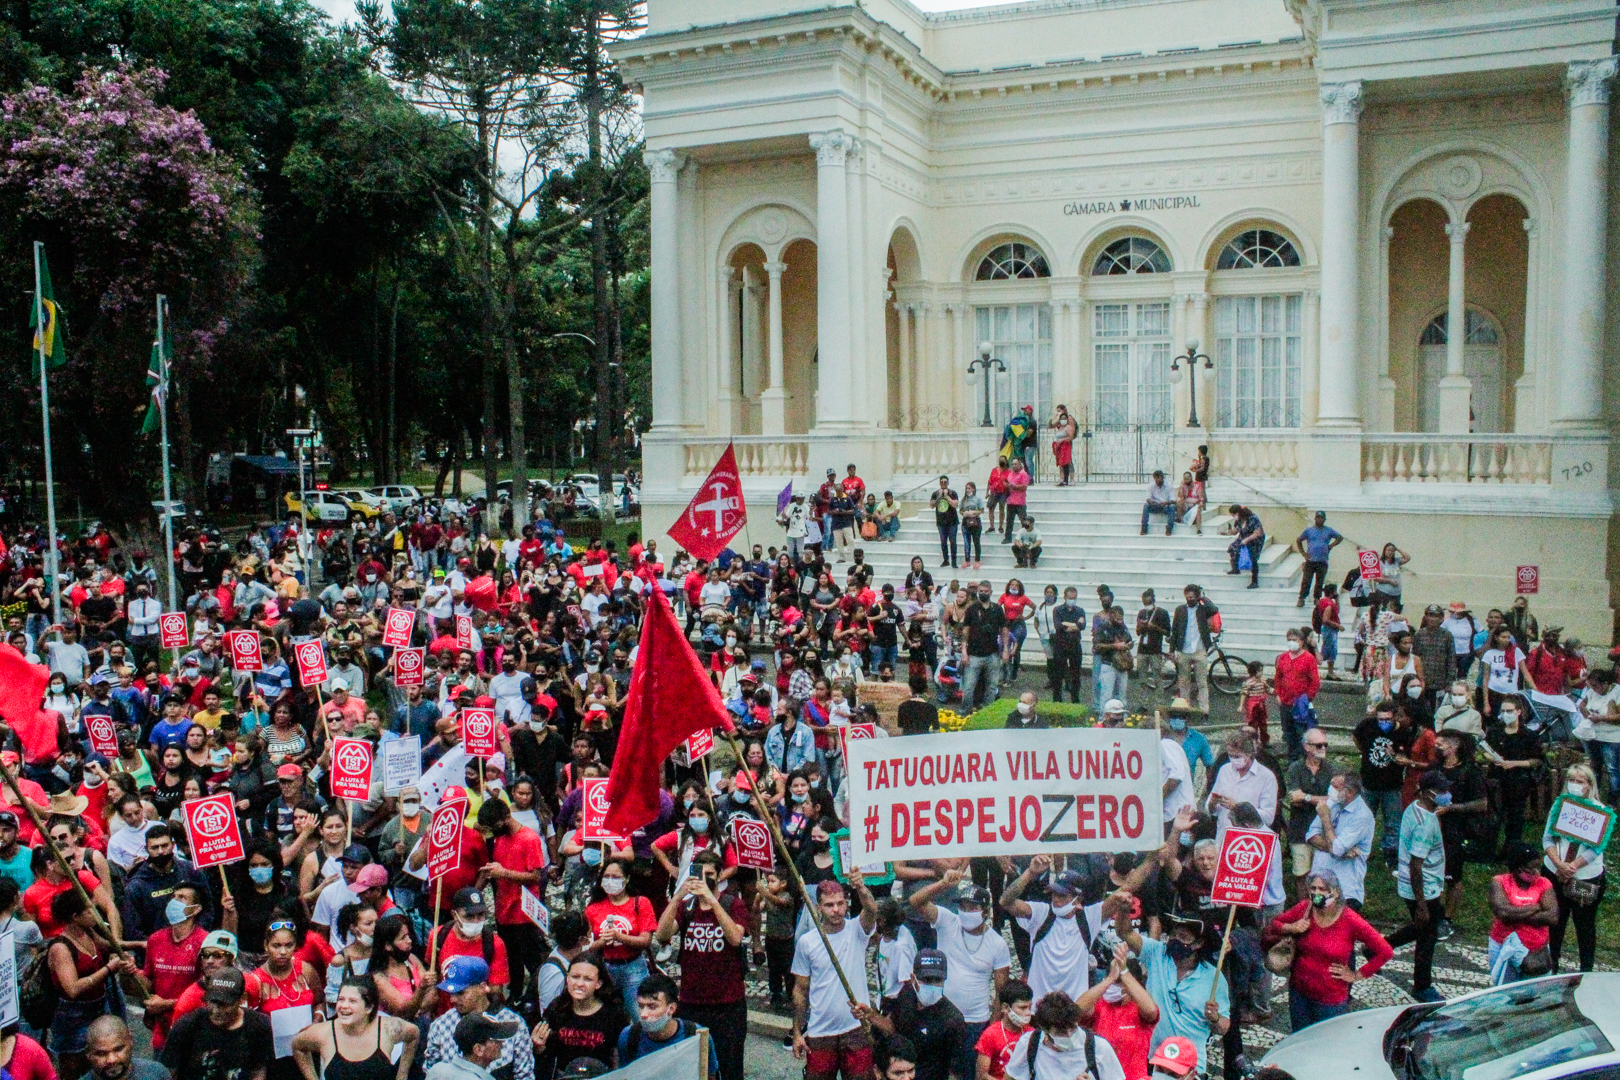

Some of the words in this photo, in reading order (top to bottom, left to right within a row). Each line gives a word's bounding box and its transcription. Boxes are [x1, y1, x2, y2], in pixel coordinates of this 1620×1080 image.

[1063, 202, 1116, 216] CÂMARA
[1134, 196, 1200, 210] MUNICIPAL
[864, 751, 997, 791] TATUQUARA
[1006, 750, 1060, 780] VILA
[1068, 742, 1142, 780] UNIÃO
[208, 837, 225, 845] LUTA
[213, 840, 236, 850] VALER!
[436, 847, 450, 857] LUTA
